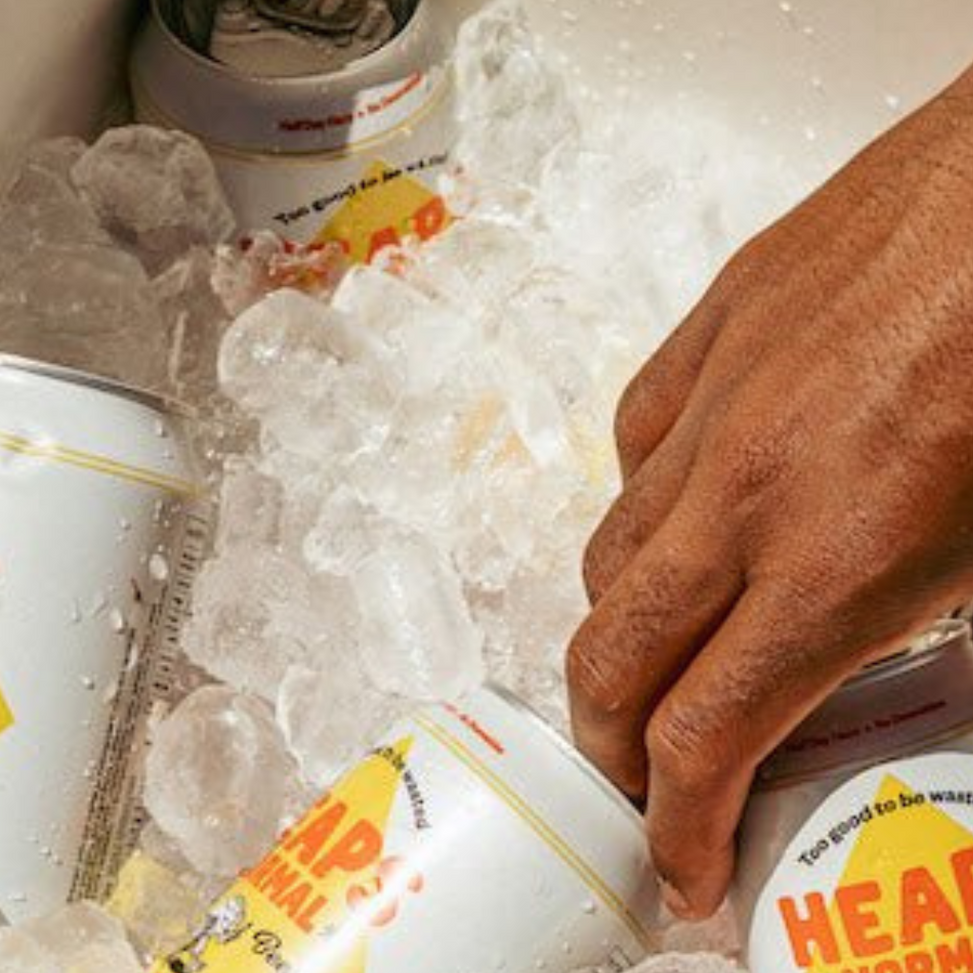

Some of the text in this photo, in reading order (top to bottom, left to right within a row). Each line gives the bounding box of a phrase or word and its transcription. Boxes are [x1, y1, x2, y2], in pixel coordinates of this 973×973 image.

[404, 769, 431, 829] wasted
[797, 838, 829, 866] Too
[829, 803, 873, 844] good
[874, 797, 897, 816] to
[899, 791, 925, 808] be
[238, 852, 331, 933] MAL
[270, 792, 424, 927] APS
